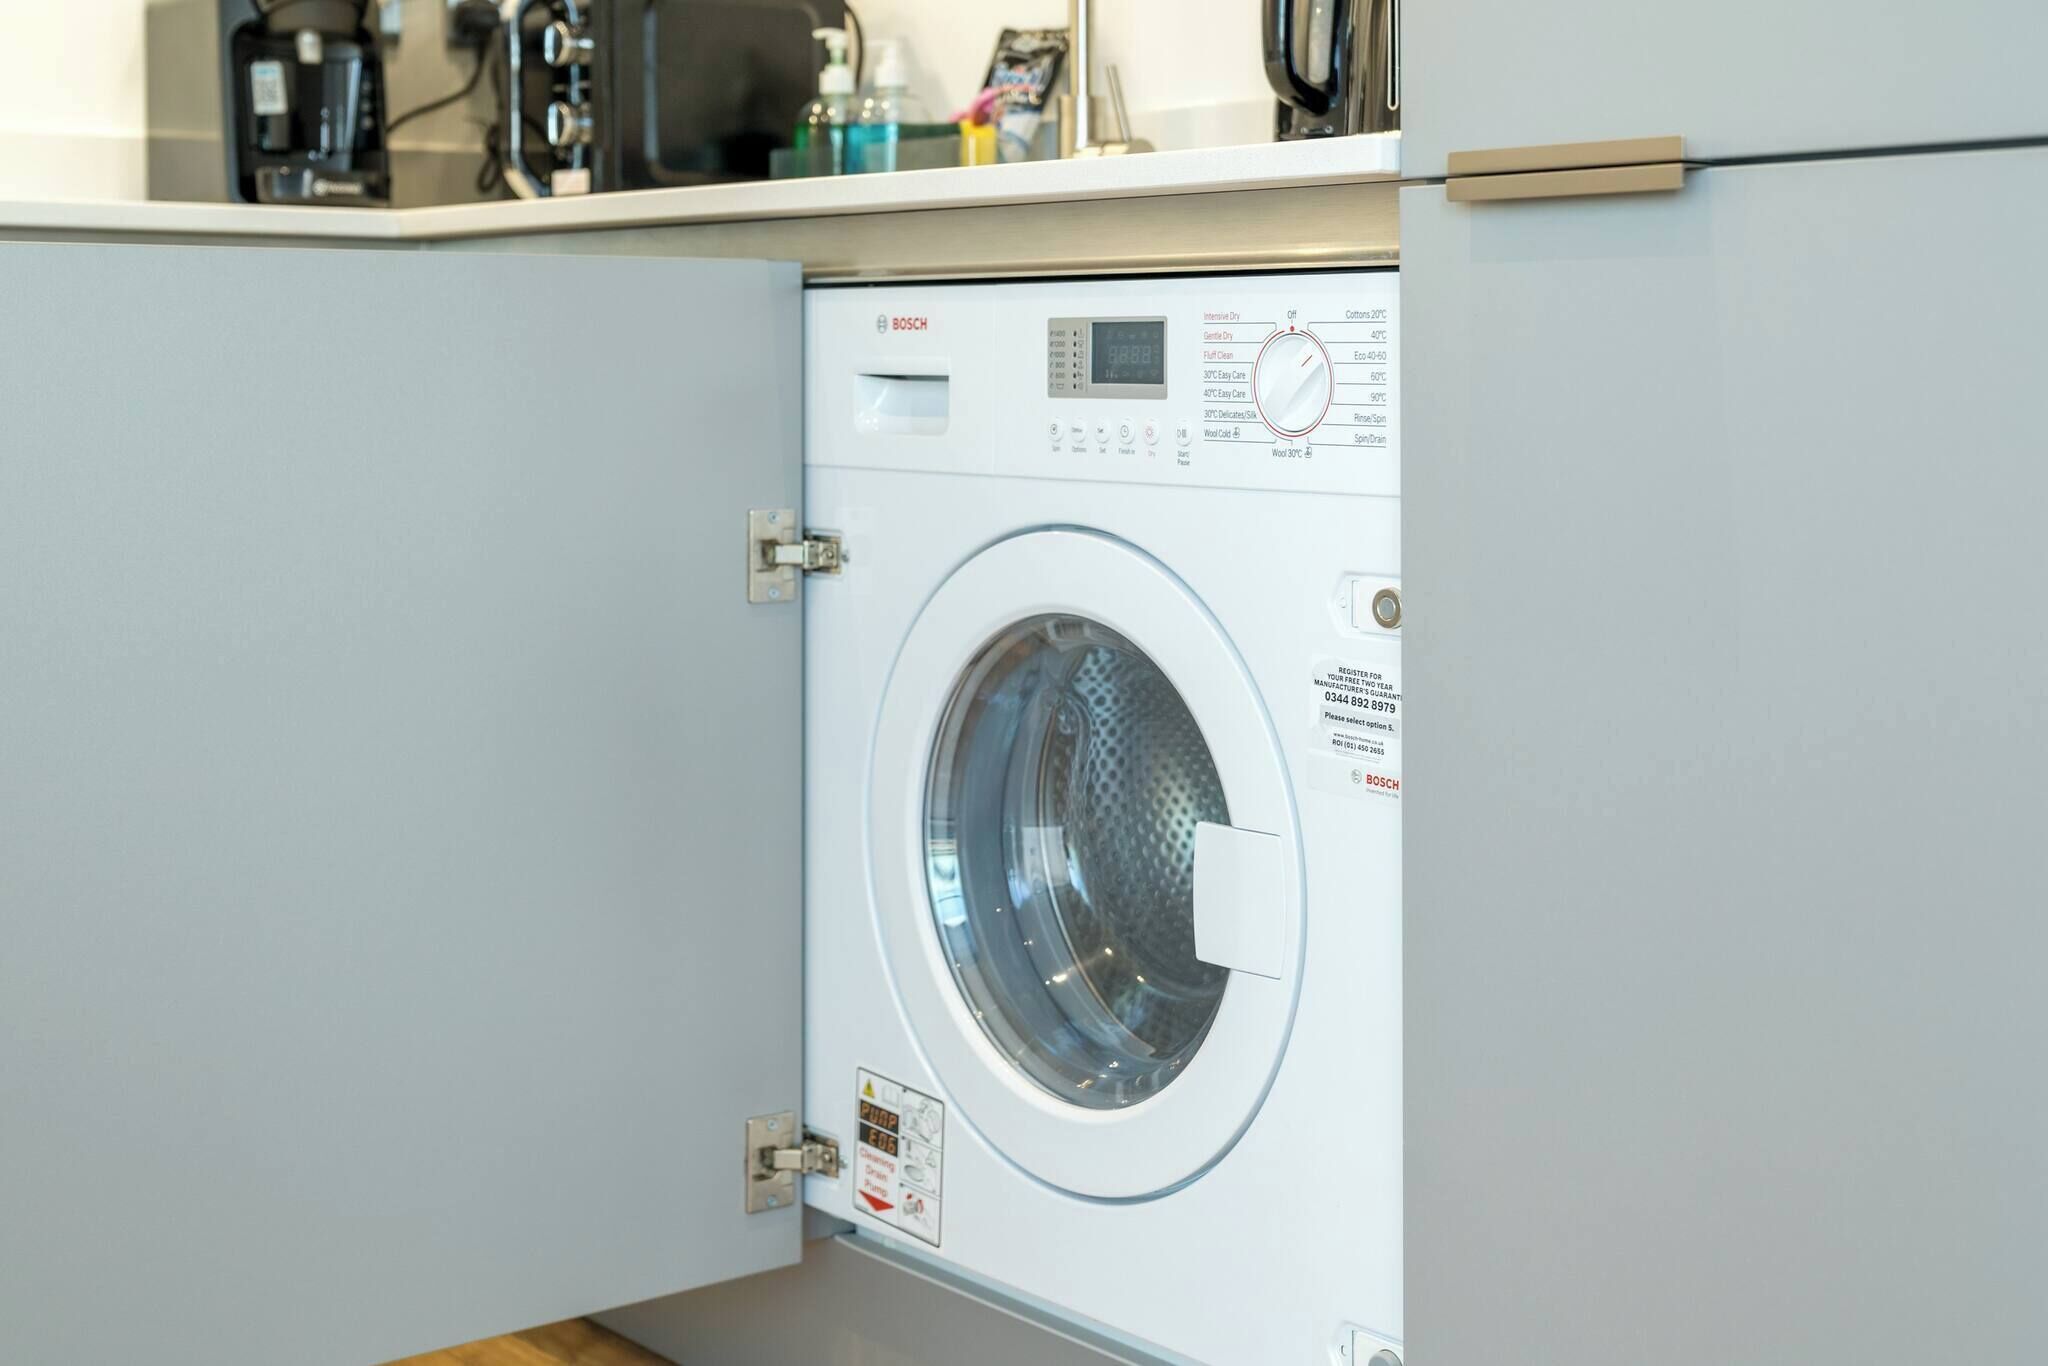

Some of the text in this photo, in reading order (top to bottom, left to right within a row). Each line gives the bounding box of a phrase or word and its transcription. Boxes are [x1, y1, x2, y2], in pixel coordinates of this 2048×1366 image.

[1203, 311, 1240, 322] Intensive Dry
[1287, 310, 1297, 319] Off
[1345, 310, 1370, 319] Cottons
[892, 317, 928, 330] BOSCH
[1203, 331, 1233, 342] Gentle Dry
[1203, 350, 1233, 359] Fluff Clean
[1354, 350, 1387, 360] Eco 40-60
[1218, 370, 1232, 381] Easy
[1232, 371, 1246, 380] Care
[1218, 389, 1232, 399] Easy
[1232, 390, 1246, 399] Care
[1218, 410, 1258, 420] Delicates/Silk
[1354, 412, 1387, 424] Rinse/Spin
[1203, 428, 1231, 438] Wool Cold
[1354, 434, 1387, 444] Spin/Drain
[1271, 447, 1287, 457] Wool
[1338, 667, 1382, 680] REGISTER FOR
[1314, 679, 1369, 695] MANUFACTURER'S
[1327, 673, 1393, 691] YOUR FREE TWO YEAR
[1325, 691, 1396, 714] 0344 892 8979
[1324, 711, 1395, 732] Please select option 5.
[1332, 739, 1343, 747] ROI
[1344, 741, 1356, 750] (01)
[1357, 744, 1369, 752] 450
[1366, 774, 1399, 790] BOSCH
[859, 1146, 896, 1173] Cleaning
[864, 1164, 888, 1182] Drain
[864, 1178, 888, 1198] Pump
